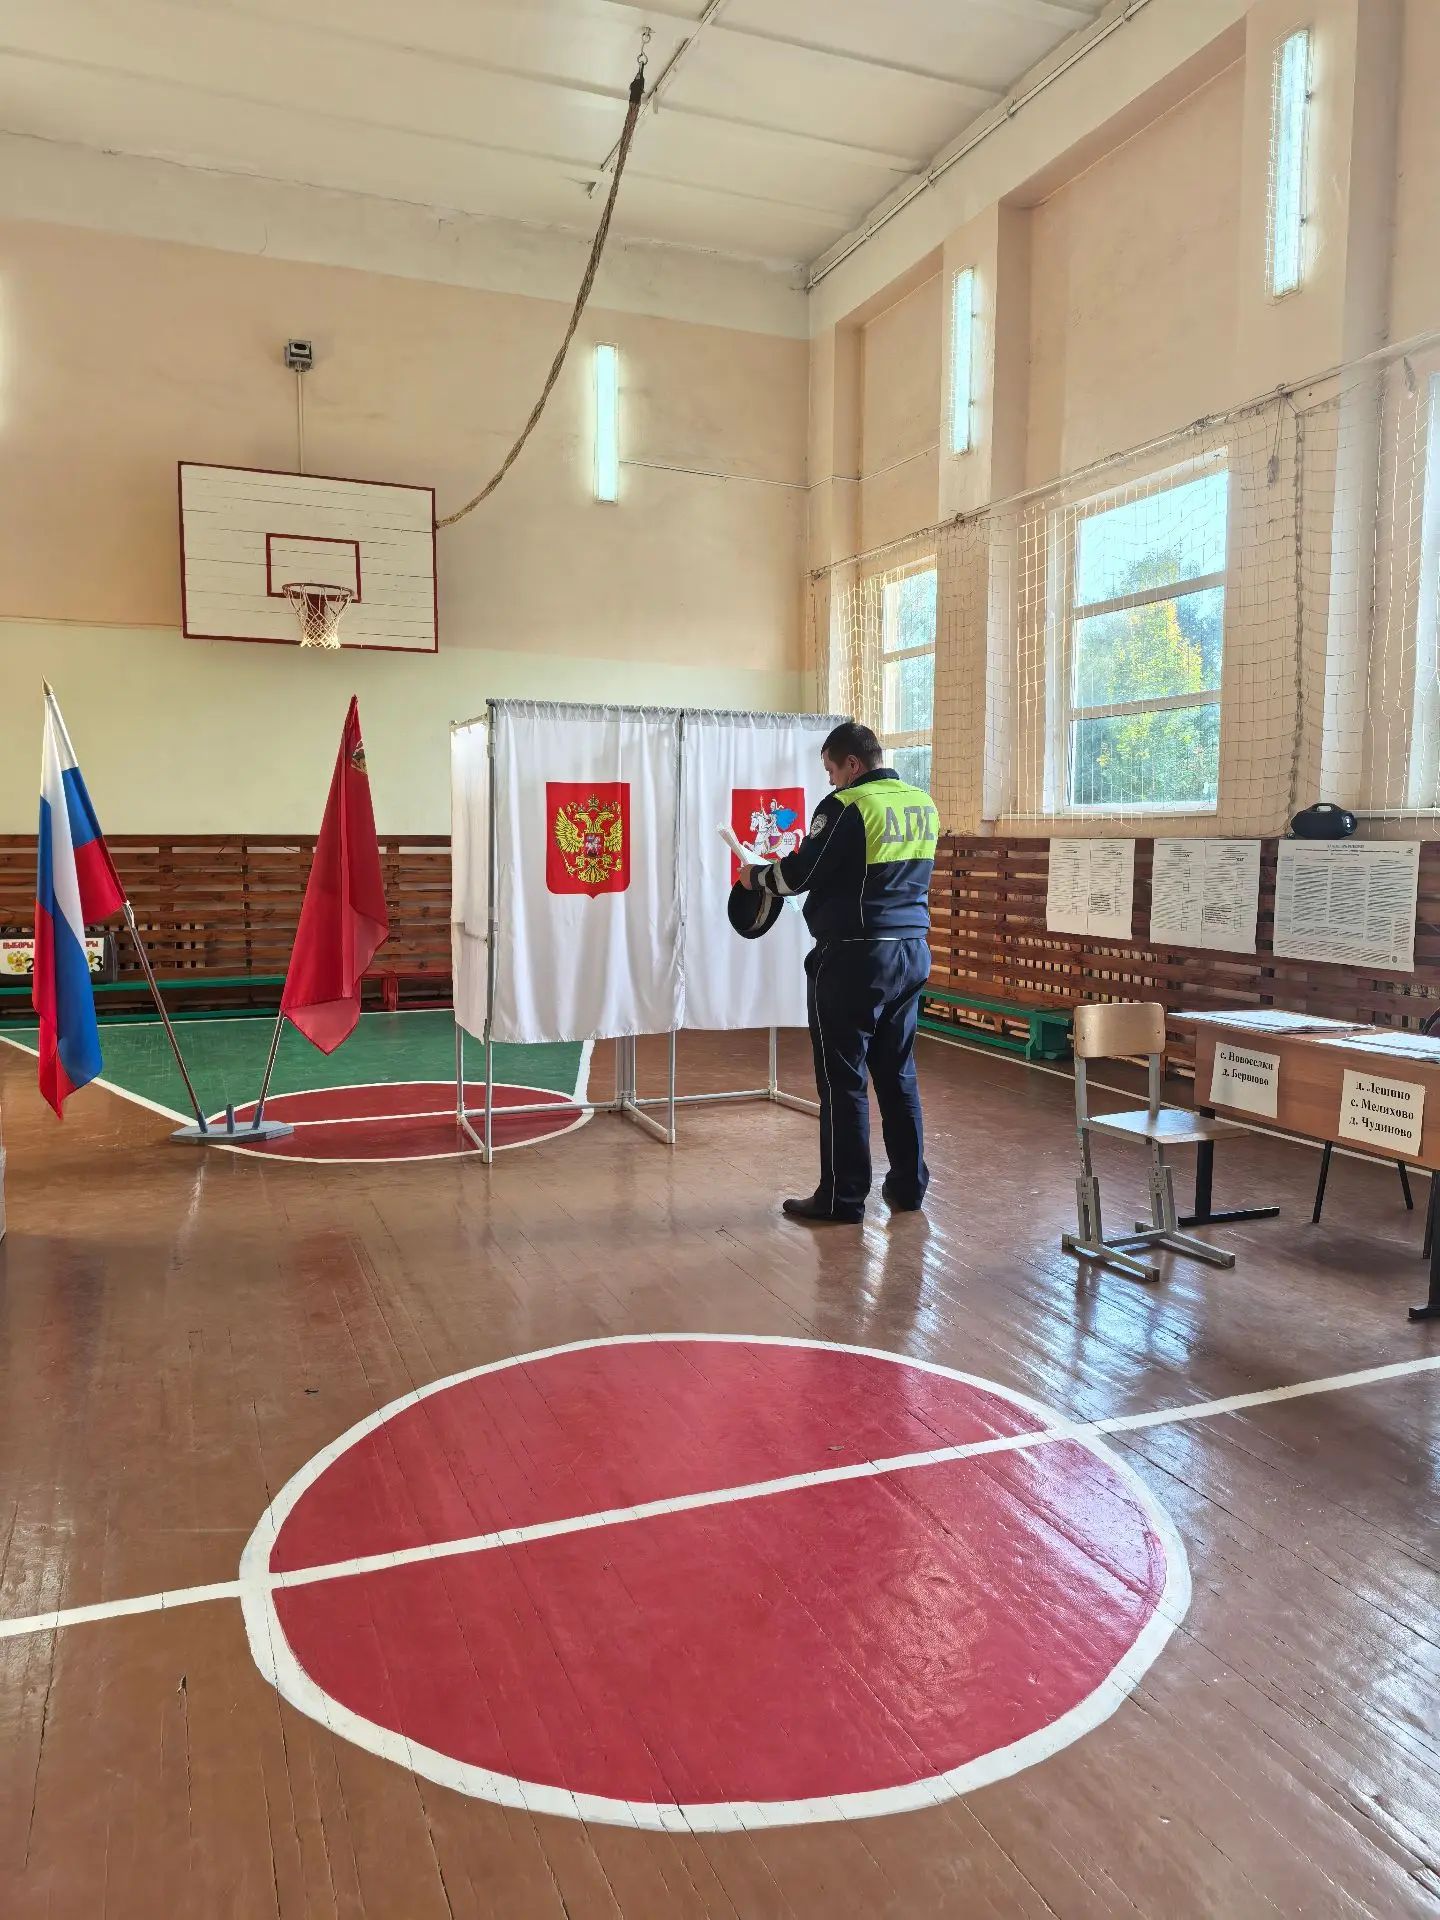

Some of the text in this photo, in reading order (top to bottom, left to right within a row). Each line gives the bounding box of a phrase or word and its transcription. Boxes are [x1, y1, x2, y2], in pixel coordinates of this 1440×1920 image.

[879, 805, 935, 843] ДПС
[25, 957, 34, 973] 2
[1231, 1068, 1269, 1086] Бершово
[1350, 1098, 1414, 1120] с. Мелихово
[1348, 1116, 1413, 1139] д. Чудиново
